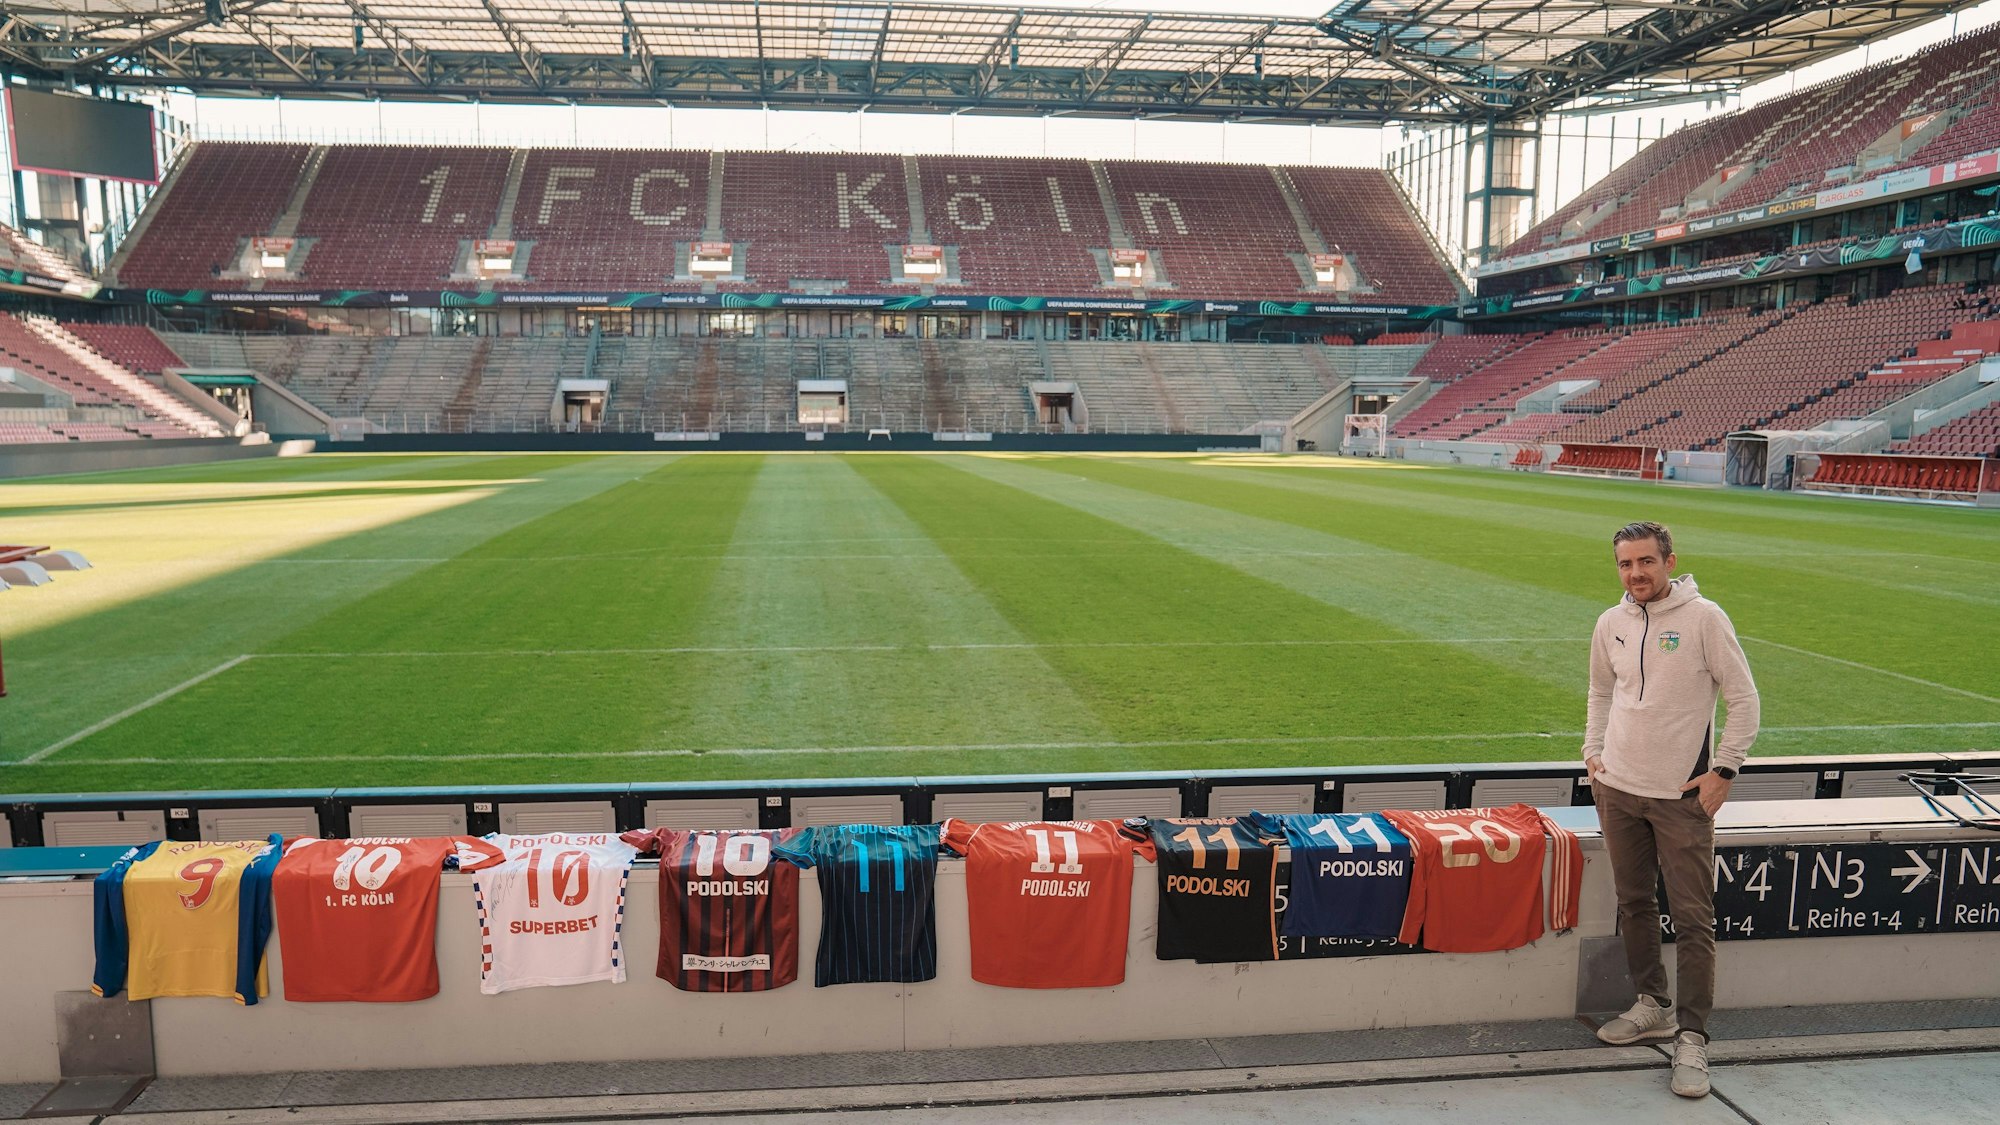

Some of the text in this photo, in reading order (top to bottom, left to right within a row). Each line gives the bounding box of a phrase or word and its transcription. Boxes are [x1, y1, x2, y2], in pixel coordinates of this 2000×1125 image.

[420, 166, 1188, 234] 1. FC Köln
[1819, 187, 1864, 205] CARGLASS
[211, 293, 228, 301] UEFA
[1025, 829, 1084, 875] 11
[1172, 826, 1241, 871] 11
[1308, 817, 1392, 854] 11
[1424, 819, 1521, 868] 20
[333, 846, 402, 890] 10
[695, 834, 770, 877] 10
[851, 839, 905, 893] 11
[1320, 860, 1404, 877] PODOLSKI
[177, 858, 225, 909] 9
[514, 848, 591, 908] 10
[687, 880, 769, 897] PODOLSKI
[1020, 879, 1091, 897] PODOLSKI
[1166, 874, 1250, 898] PODOLSKI
[1810, 851, 1865, 899] N3
[325, 891, 394, 907] 1. FC KÖLN
[509, 915, 598, 935] SUPERBET
[1723, 915, 1755, 937] 1-4
[1807, 906, 1902, 931] Reihe 1-4
